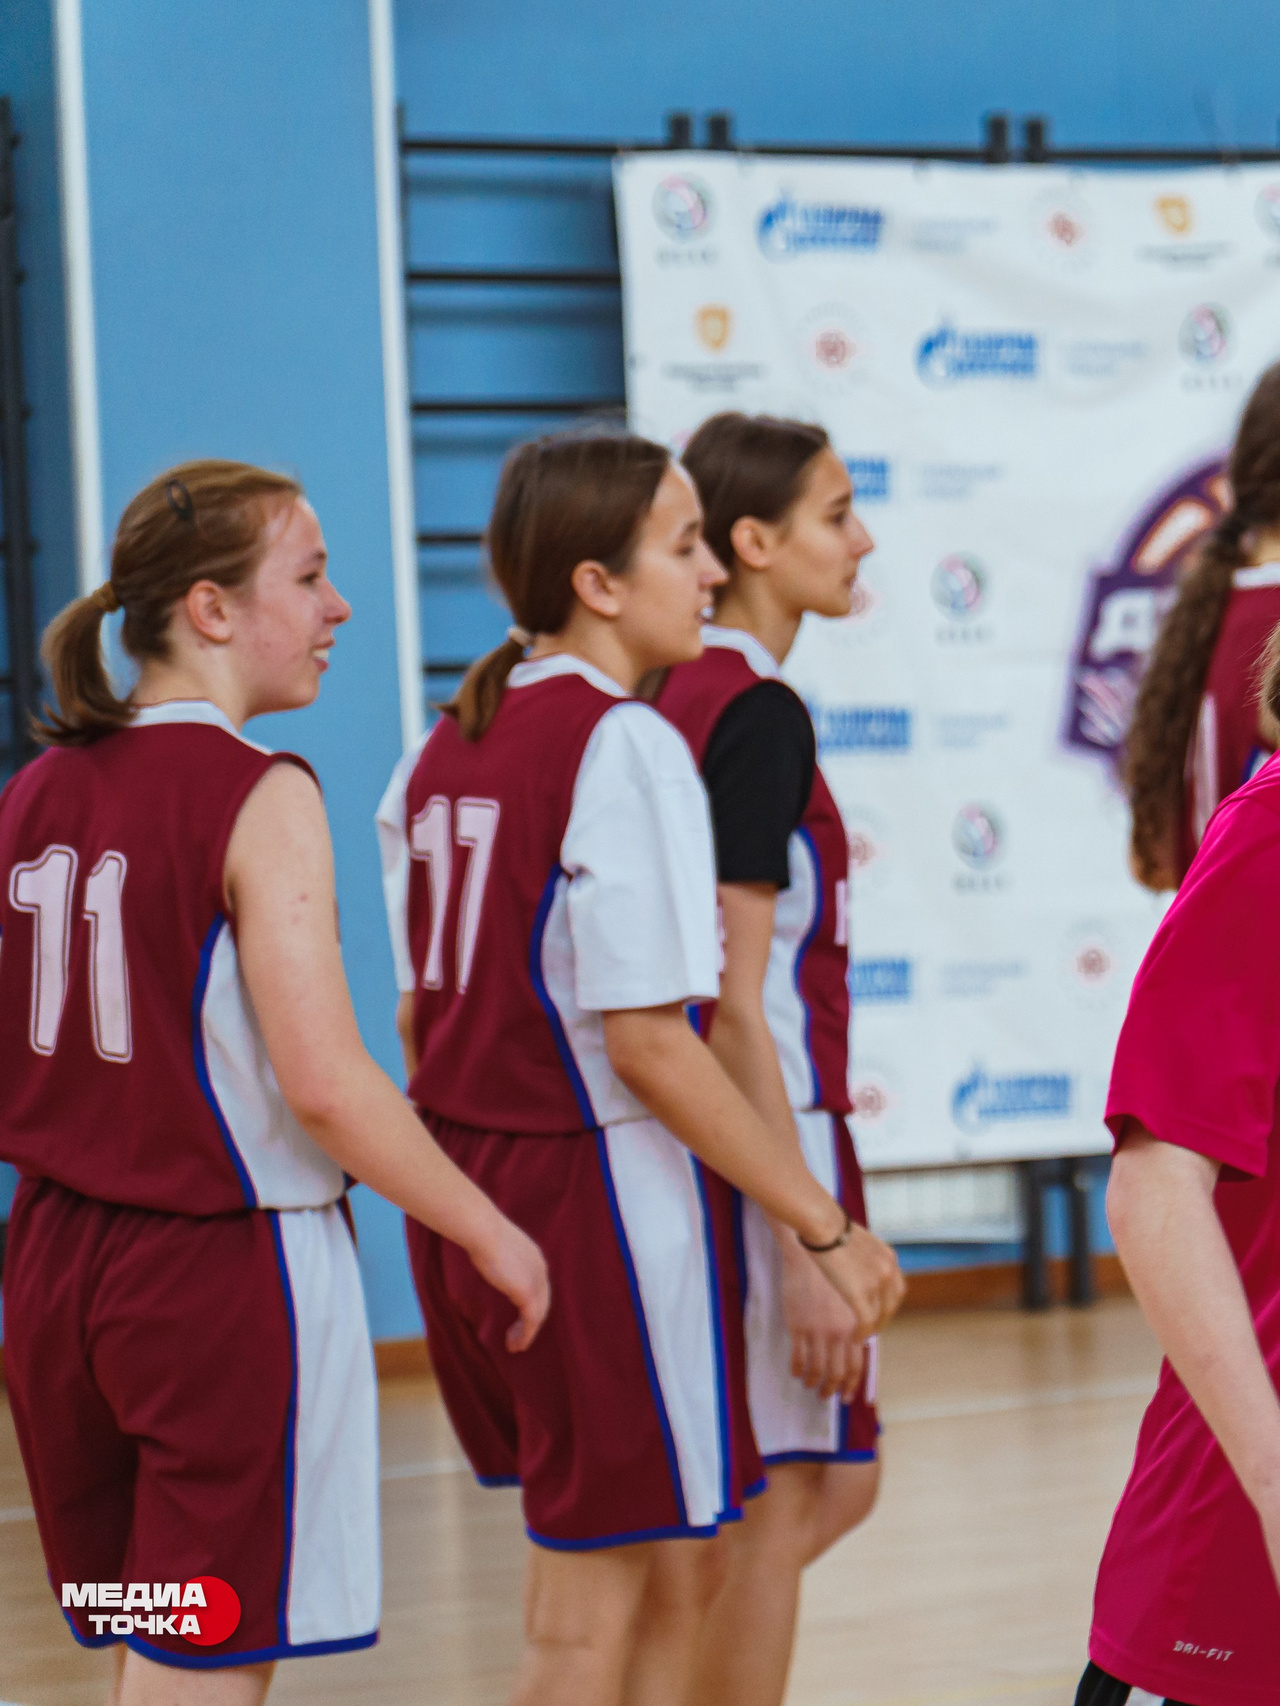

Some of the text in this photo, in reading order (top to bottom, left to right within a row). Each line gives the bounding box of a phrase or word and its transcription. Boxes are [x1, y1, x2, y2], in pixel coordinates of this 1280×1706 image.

[9, 844, 133, 1063] 11
[410, 795, 500, 994] 17
[1173, 1640, 1234, 1662] DRI-FIT
